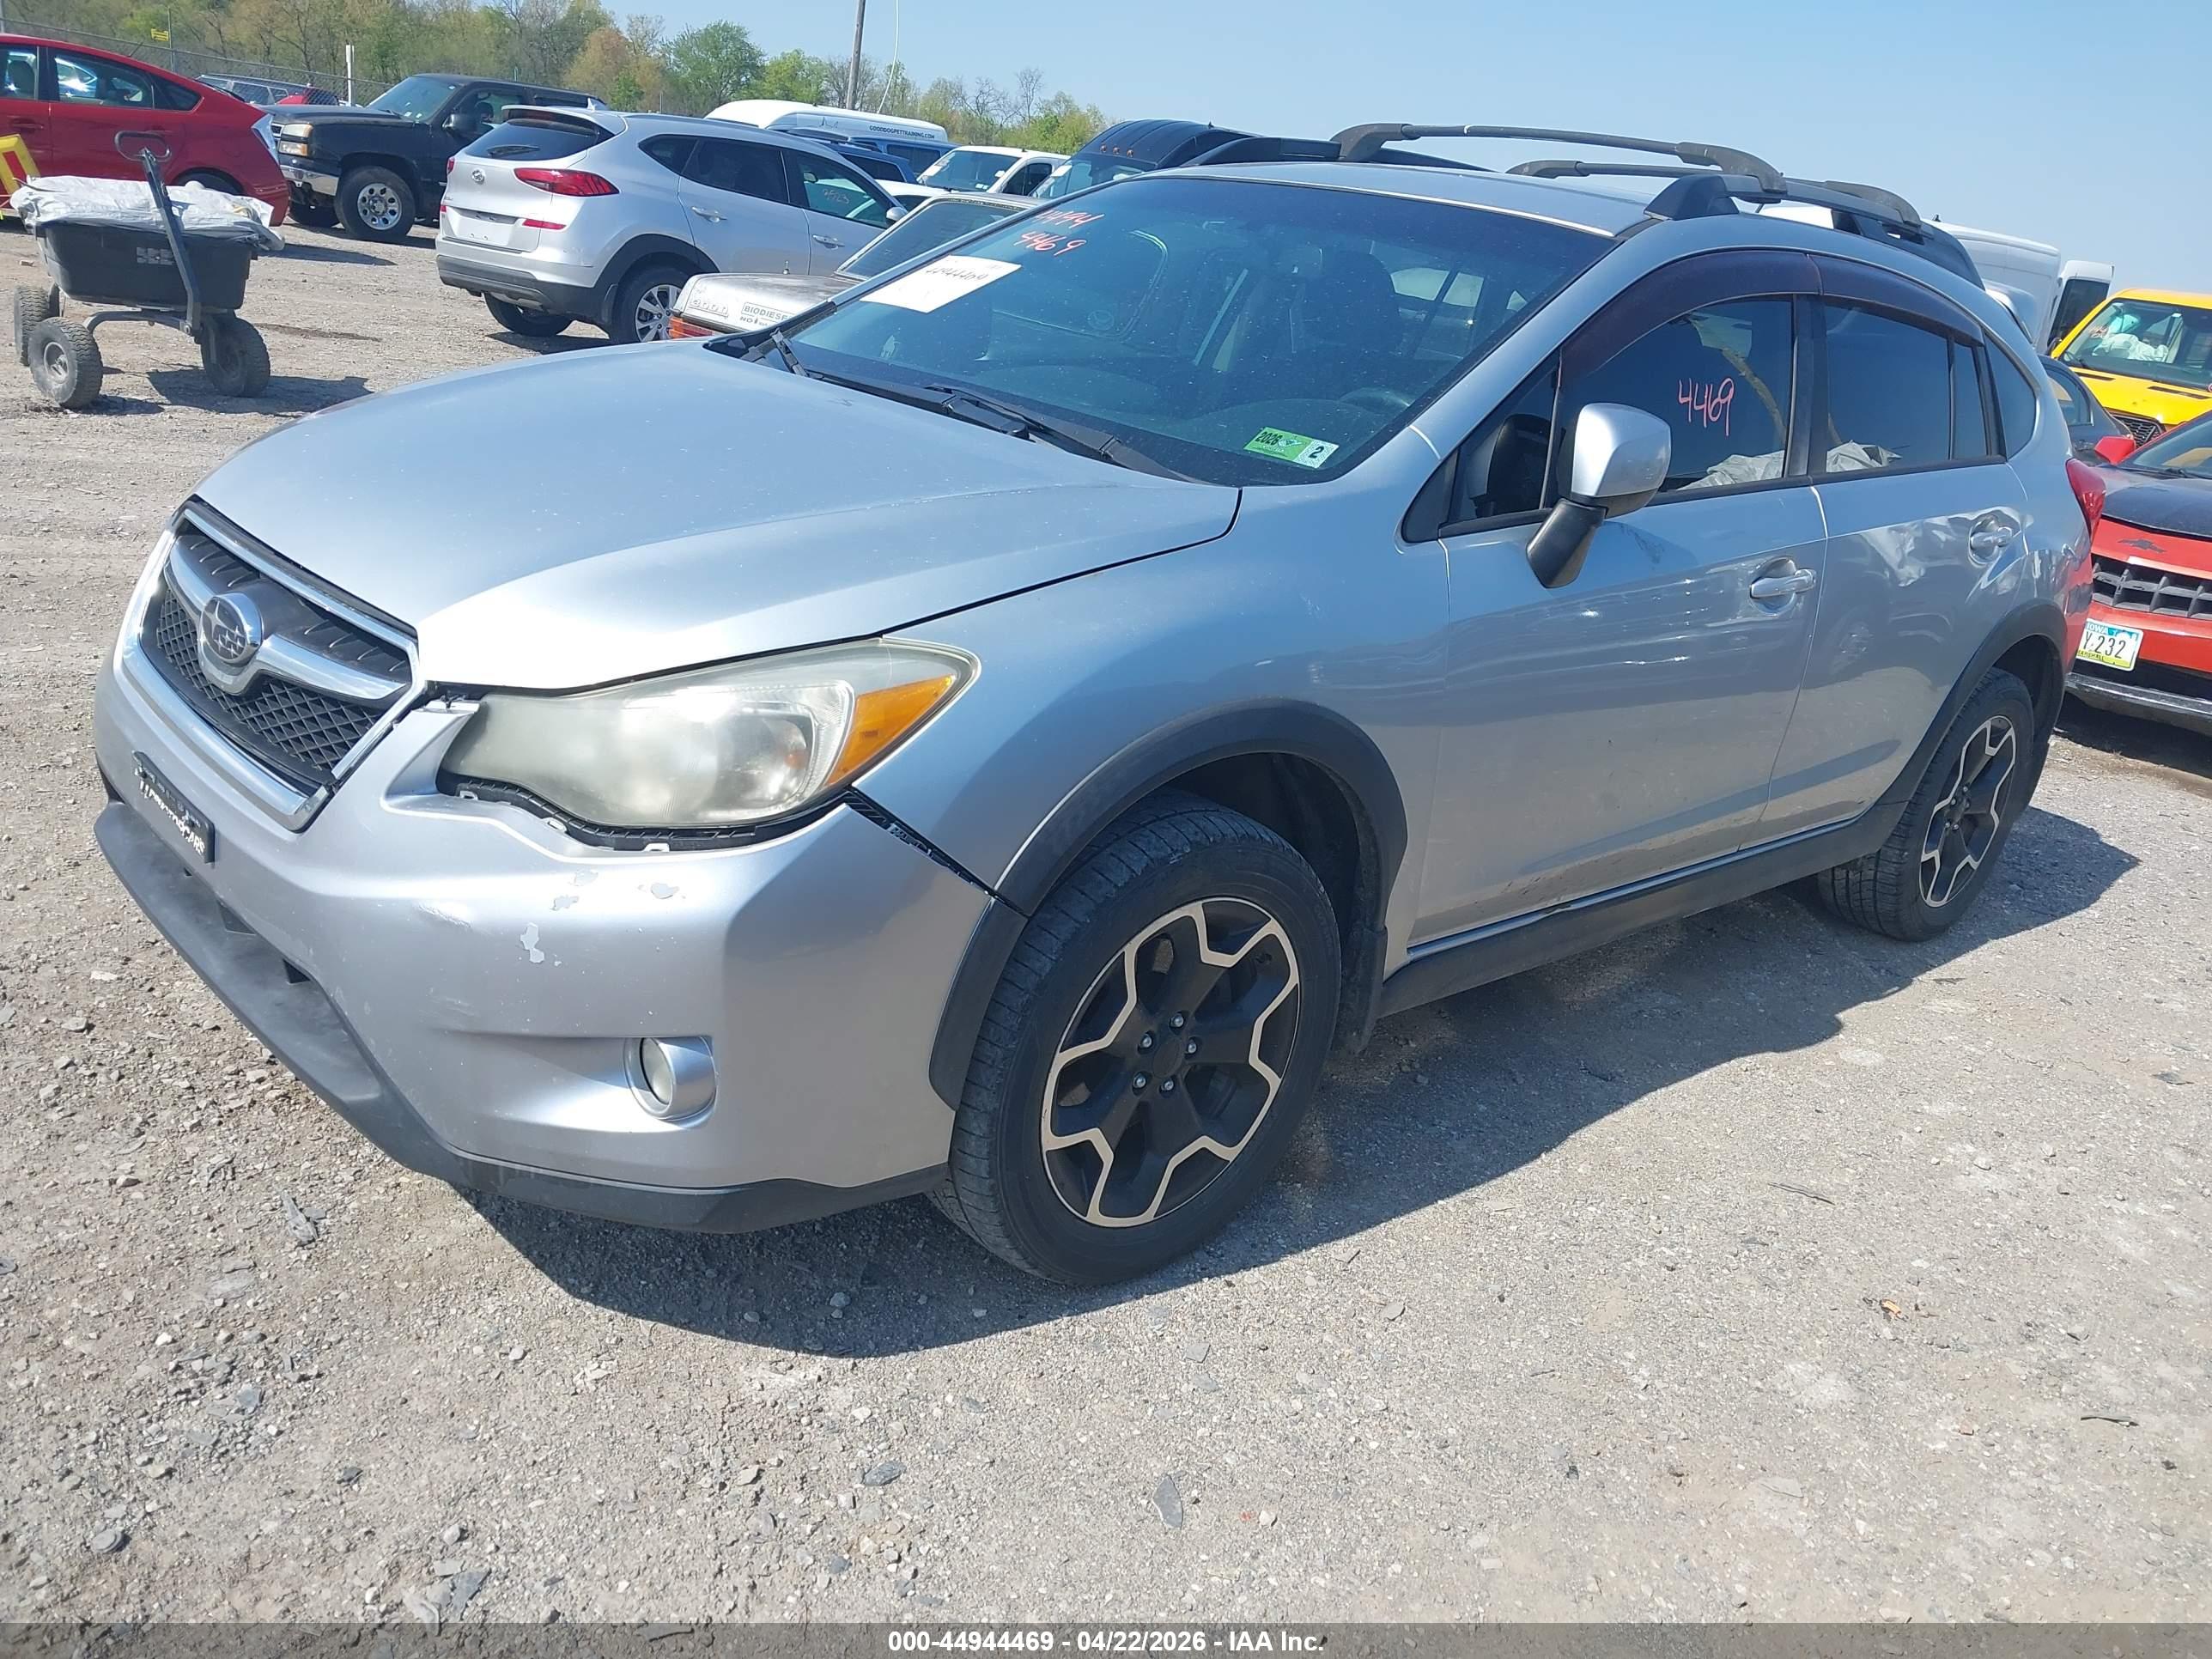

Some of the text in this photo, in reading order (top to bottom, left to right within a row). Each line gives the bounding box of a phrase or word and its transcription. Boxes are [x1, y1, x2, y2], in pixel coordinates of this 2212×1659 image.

[744, 305, 794, 322] BIODIESE
[1678, 377, 1735, 437] 4469
[1255, 431, 1283, 446] 2026
[1308, 446, 1325, 459] 2
[2086, 622, 2109, 635] IOWA
[2094, 635, 2127, 659] 232
